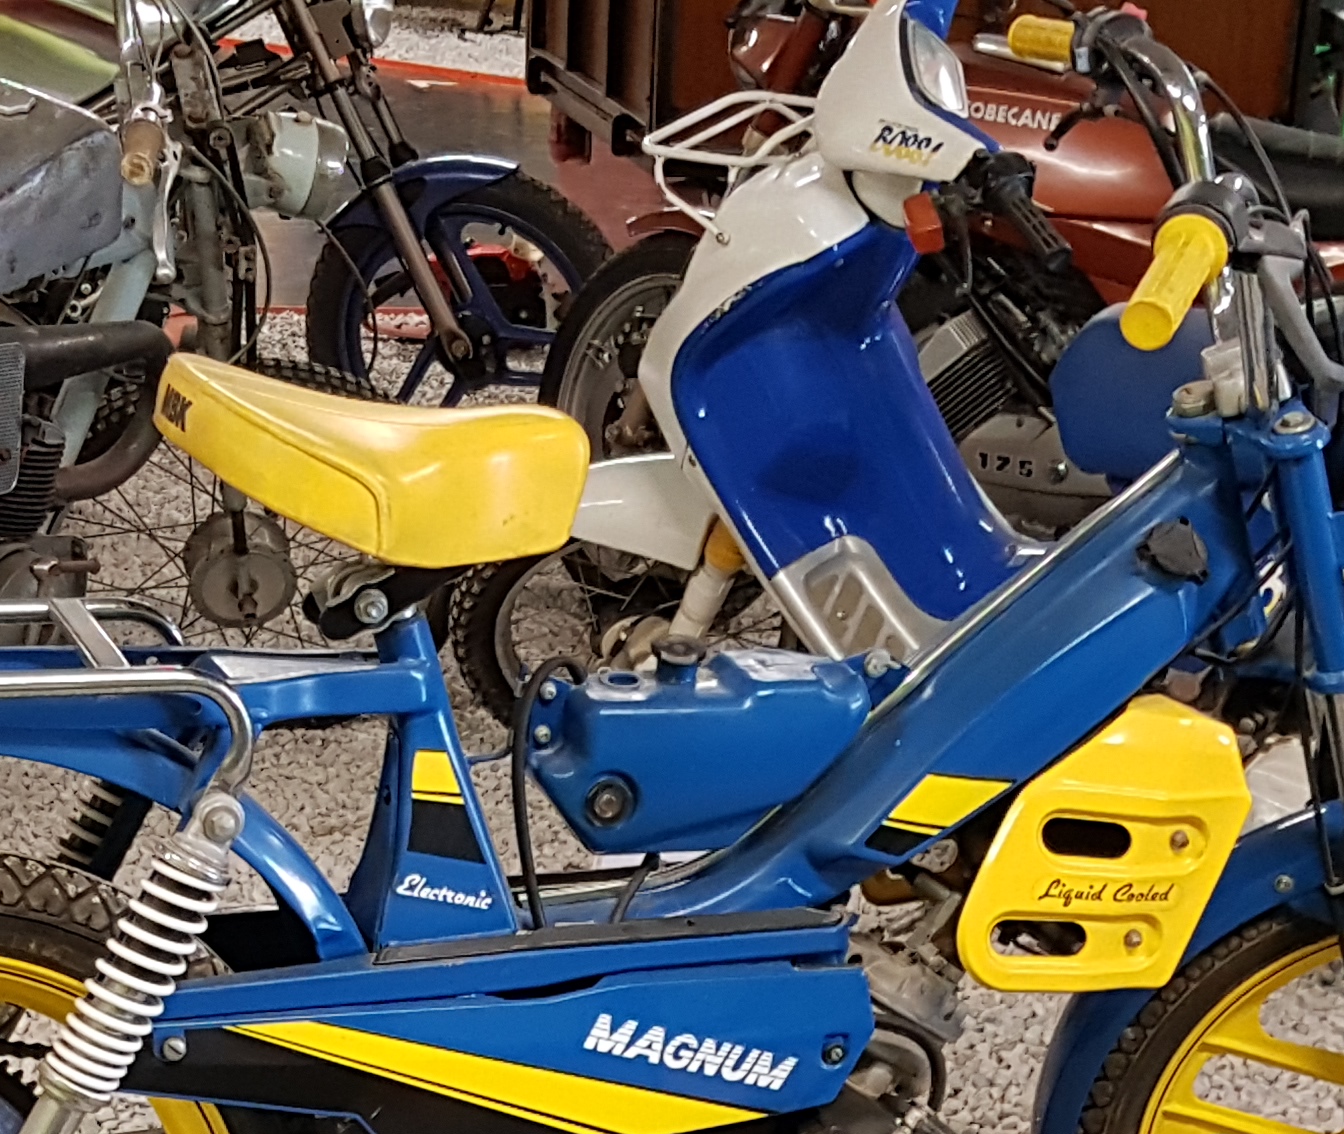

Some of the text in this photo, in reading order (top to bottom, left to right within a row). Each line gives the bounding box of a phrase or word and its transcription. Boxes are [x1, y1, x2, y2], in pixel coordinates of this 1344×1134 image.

[968, 100, 1062, 132] OBECANE
[979, 452, 1033, 478] 175
[396, 873, 493, 910] Electronic
[1038, 878, 1175, 907] Liquid Cooled
[583, 1013, 800, 1091] MAGNUM
